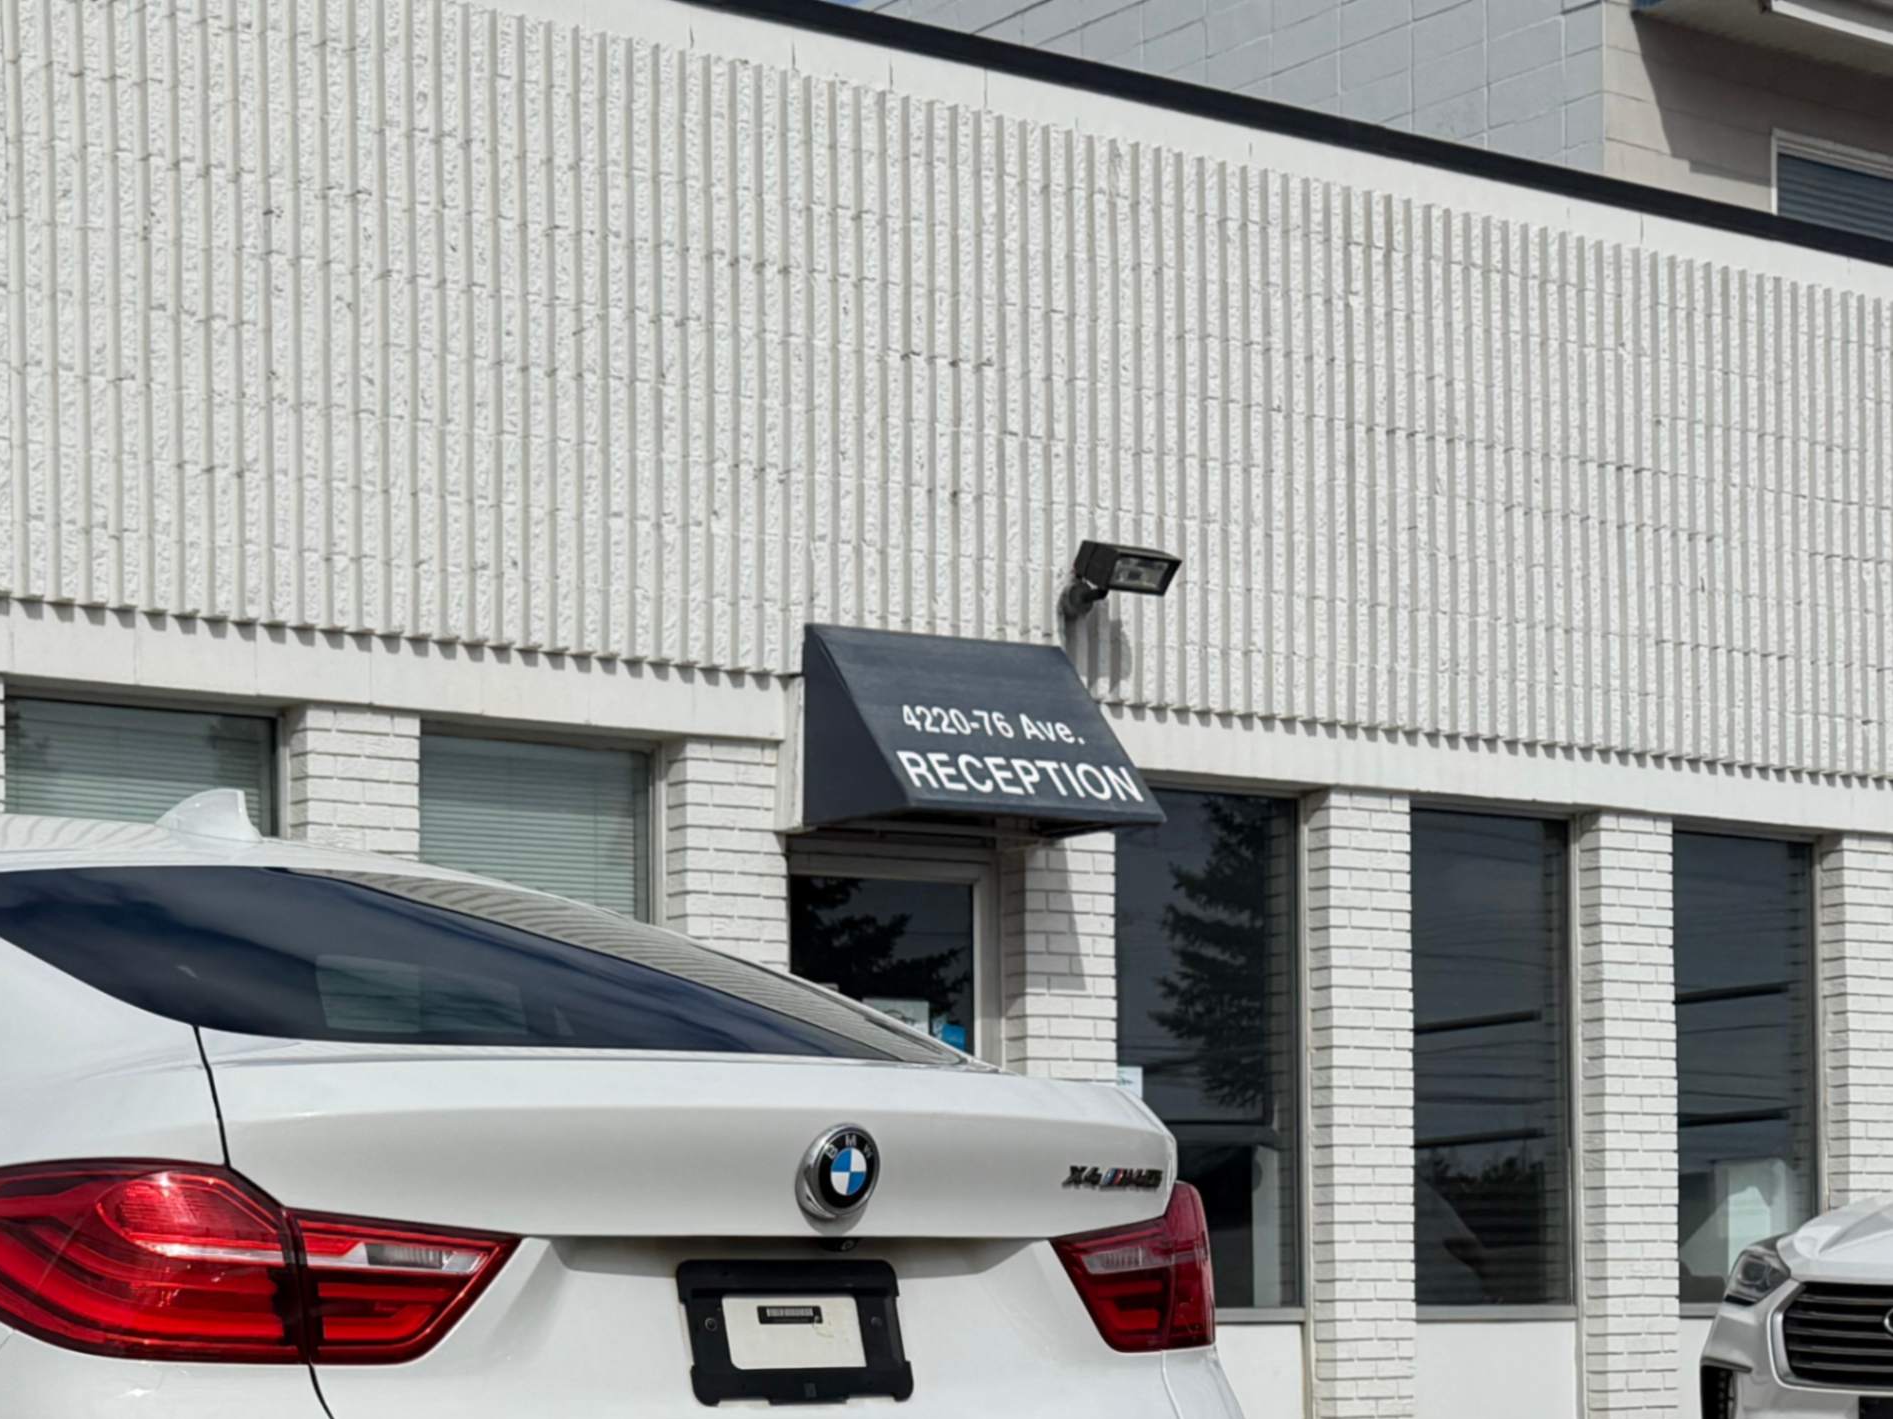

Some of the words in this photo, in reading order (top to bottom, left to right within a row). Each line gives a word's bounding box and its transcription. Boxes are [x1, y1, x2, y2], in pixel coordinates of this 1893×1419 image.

[901, 703, 1014, 739] 4220-76
[1021, 713, 1086, 746] Ave.
[896, 750, 1145, 803] RECEPTION
[825, 1134, 873, 1159] BMW
[1062, 1165, 1102, 1188] X4
